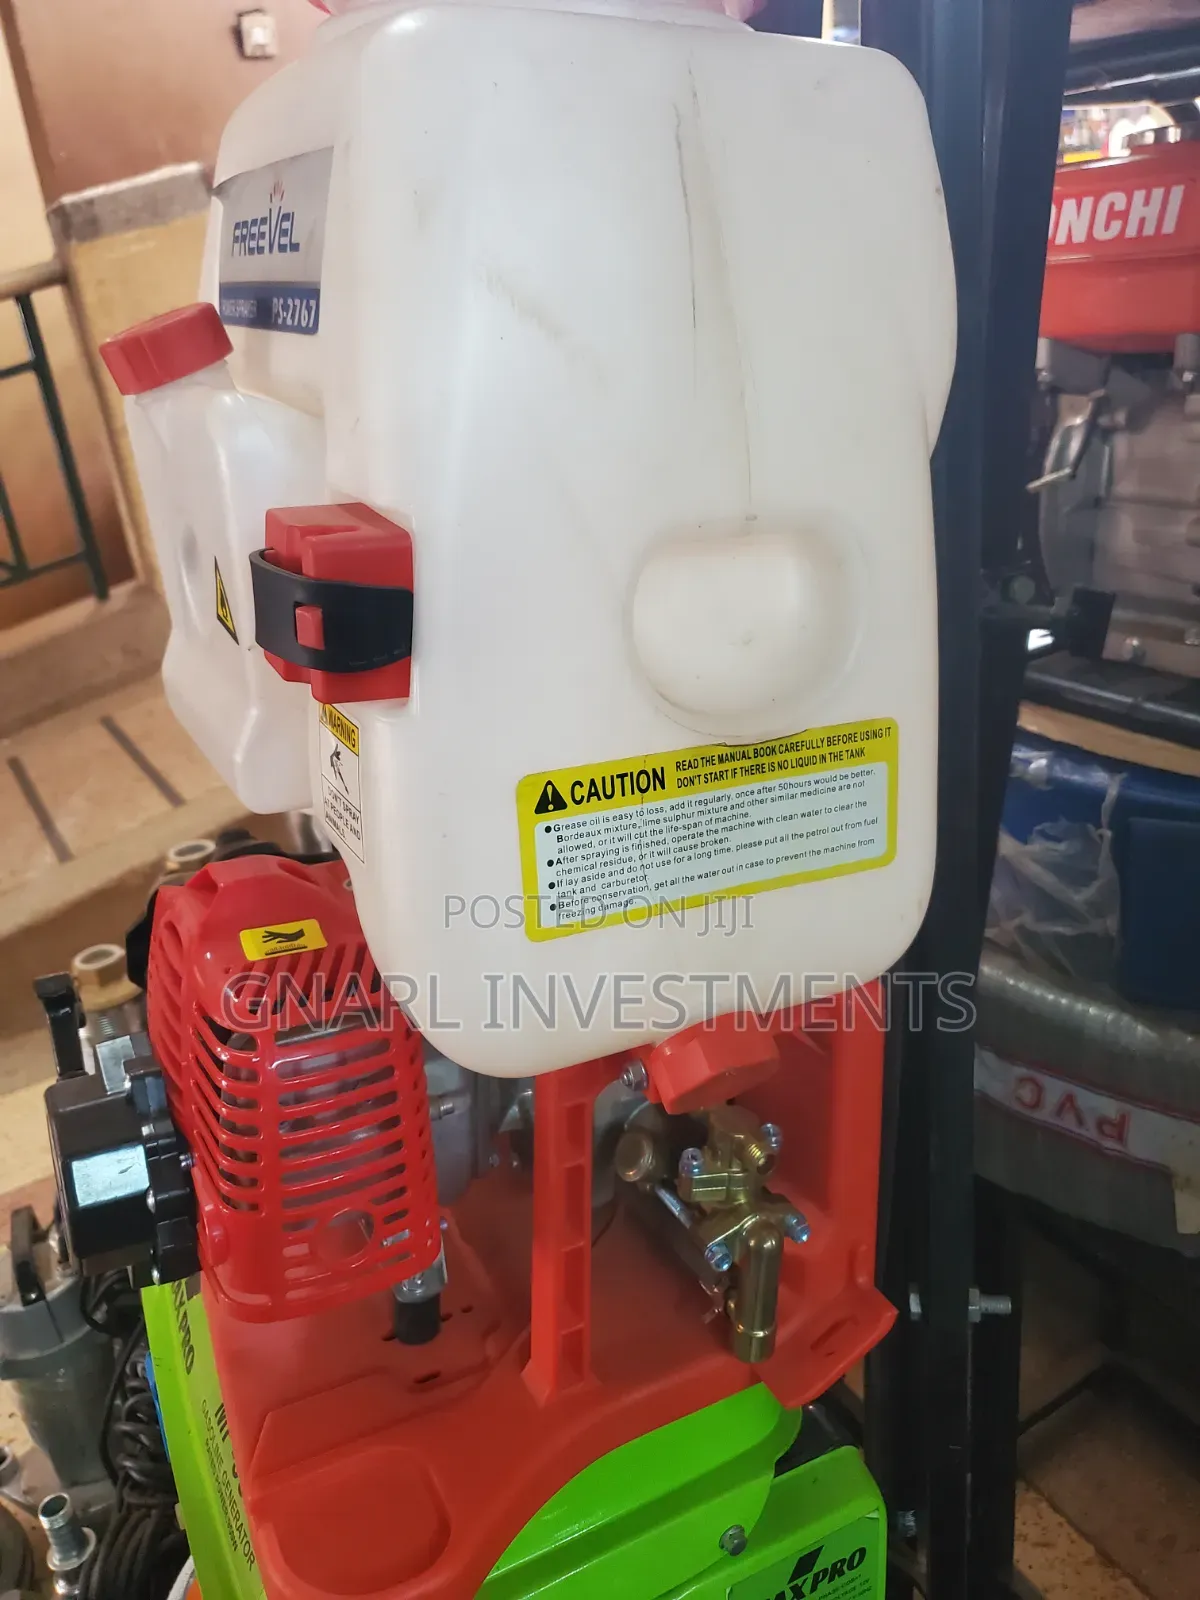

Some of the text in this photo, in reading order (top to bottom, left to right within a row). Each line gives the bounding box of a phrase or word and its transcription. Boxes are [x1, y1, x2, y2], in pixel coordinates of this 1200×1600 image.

[232, 206, 300, 257] FREEVEL
[1049, 185, 1185, 245] NCHI
[272, 298, 316, 328] PS-2767
[328, 709, 356, 748] WARNING
[676, 727, 891, 772] READ THE MANUAL BOOK CAREFULLY BEFORE USING IT
[570, 767, 666, 805] CAUTION
[677, 747, 865, 788] DON'T START IF THERE IS NO LIQUID IN THE TANK
[324, 796, 360, 840] AT PEOPLE AND
[343, 798, 359, 825] SPRAY
[554, 820, 587, 833] Grease
[590, 818, 600, 826] oil
[602, 816, 610, 824] is
[613, 811, 633, 824] easy
[647, 806, 667, 815] loss,
[669, 802, 685, 811] add
[687, 800, 693, 808] it
[735, 789, 754, 799] once
[757, 785, 776, 796] after
[778, 780, 812, 792] 50hours
[814, 775, 837, 787] would
[557, 829, 601, 843] Bordeaux
[643, 818, 660, 827] lime
[663, 812, 695, 823] sulphur
[697, 805, 728, 819] mixture
[730, 801, 745, 810] and
[747, 795, 768, 807] other
[770, 792, 798, 803] similar
[800, 786, 836, 798] medicine
[838, 783, 851, 791] are
[853, 780, 865, 789] not
[555, 856, 578, 866] After
[581, 847, 619, 862] spraying
[622, 844, 629, 853] is
[672, 832, 704, 848] operate
[706, 828, 719, 837] the
[721, 821, 755, 833] machine
[757, 815, 773, 826] with
[776, 813, 798, 822] clean
[800, 809, 822, 818] water
[834, 803, 853, 813] clear
[855, 800, 867, 809] the
[557, 879, 564, 888] If
[565, 878, 578, 888] lay
[581, 872, 605, 883] aside
[608, 867, 624, 877] and
[626, 865, 637, 873] do
[640, 862, 653, 871] not
[656, 859, 671, 868] use
[673, 855, 685, 864] for
[694, 849, 712, 861] long
[736, 839, 762, 851] please
[764, 836, 777, 846] put
[779, 833, 789, 842] all
[791, 832, 804, 840] the
[806, 826, 829, 839] petrol
[845, 821, 862, 830] from
[864, 817, 878, 826] fuel
[617, 834, 632, 843] will
[634, 831, 647, 839] cut
[650, 827, 663, 836] the
[665, 820, 702, 836] life-span
[705, 818, 713, 826] of
[556, 863, 597, 877] chemical
[638, 853, 647, 861] or
[657, 848, 671, 858] will
[673, 844, 698, 854] cause
[558, 898, 589, 910] Before
[654, 880, 668, 890] get
[670, 876, 679, 886] all
[681, 874, 695, 883] the
[697, 868, 720, 880] water
[745, 859, 764, 868] case
[775, 852, 807, 864] prevent
[809, 848, 821, 856] the
[823, 842, 856, 854] machine
[858, 837, 874, 847] from
[557, 889, 577, 898] tank
[580, 885, 596, 894] and
[558, 905, 596, 920] freezing
[1014, 1075, 1130, 1147] PVC
[177, 1310, 194, 1375] PRO
[202, 1399, 223, 1475] GASOLINE
[222, 1470, 255, 1571] GENERATOR
[809, 1547, 867, 1594] PRO
